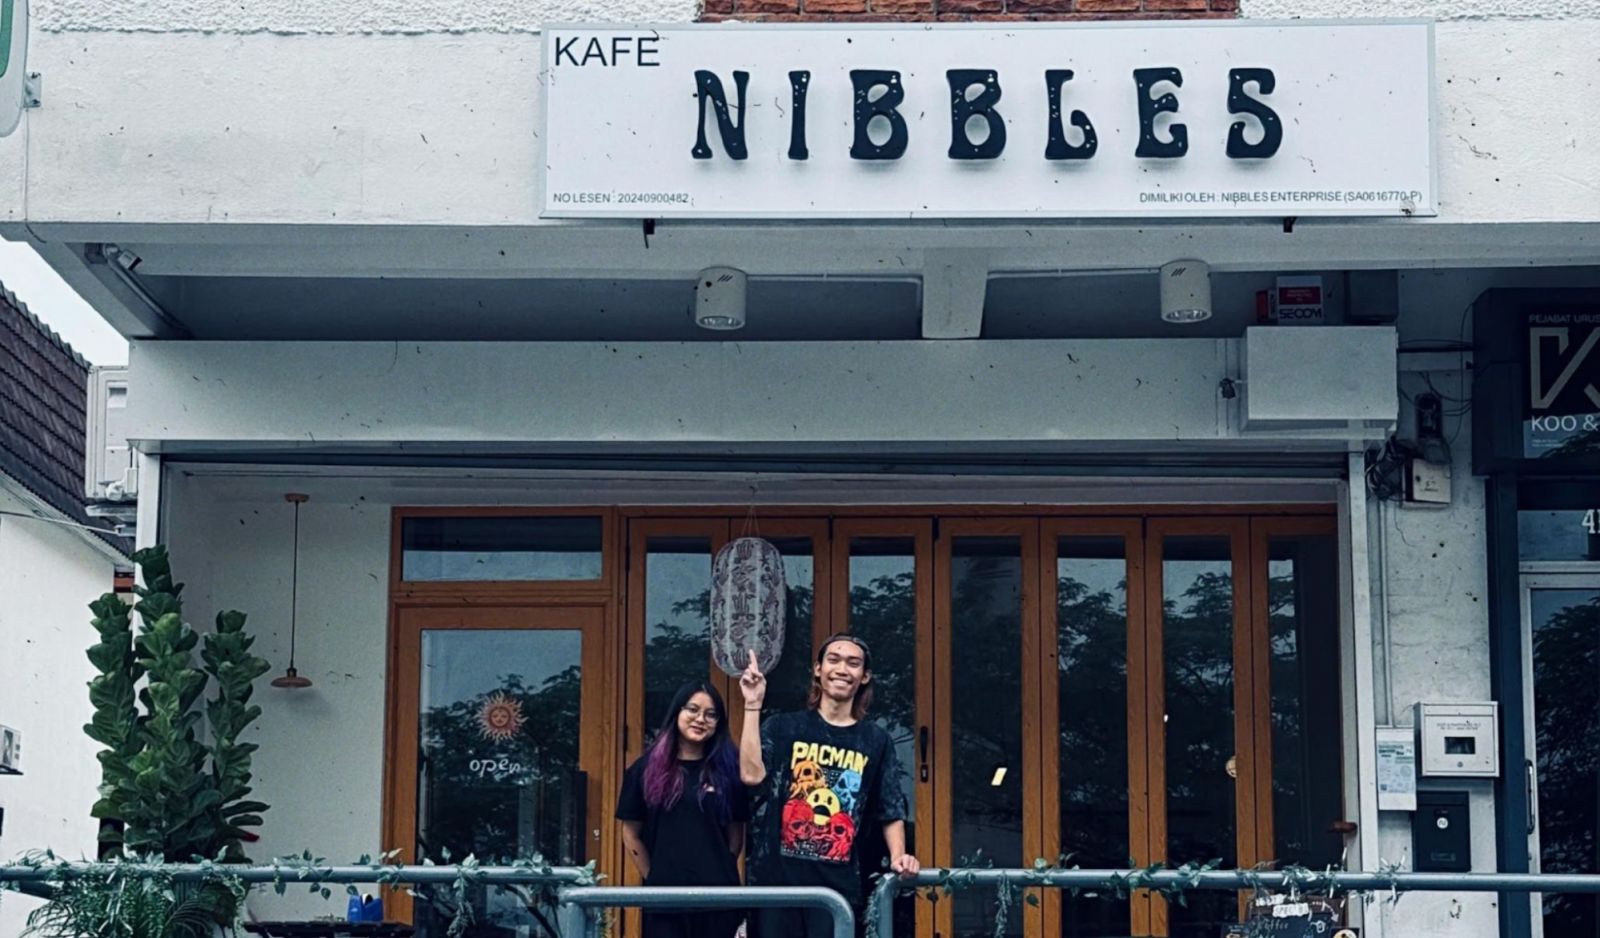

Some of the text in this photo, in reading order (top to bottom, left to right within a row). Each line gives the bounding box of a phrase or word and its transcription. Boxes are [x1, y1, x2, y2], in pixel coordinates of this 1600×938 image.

[554, 36, 662, 67] KAFE
[691, 67, 1284, 161] NIBBLES
[552, 192, 571, 203] NO
[572, 192, 611, 203] LESEN
[617, 192, 690, 203] 20240900482
[1139, 192, 1183, 203] DIMILIKI
[1183, 192, 1216, 203] OLEH
[1221, 191, 1269, 202] NIBBLES
[1270, 191, 1343, 202] ENTERPRISE
[1528, 313, 1571, 324] PEJABAT
[1531, 414, 1599, 432] KOO &
[468, 757, 522, 778] open
[790, 740, 869, 776] PACMAN
